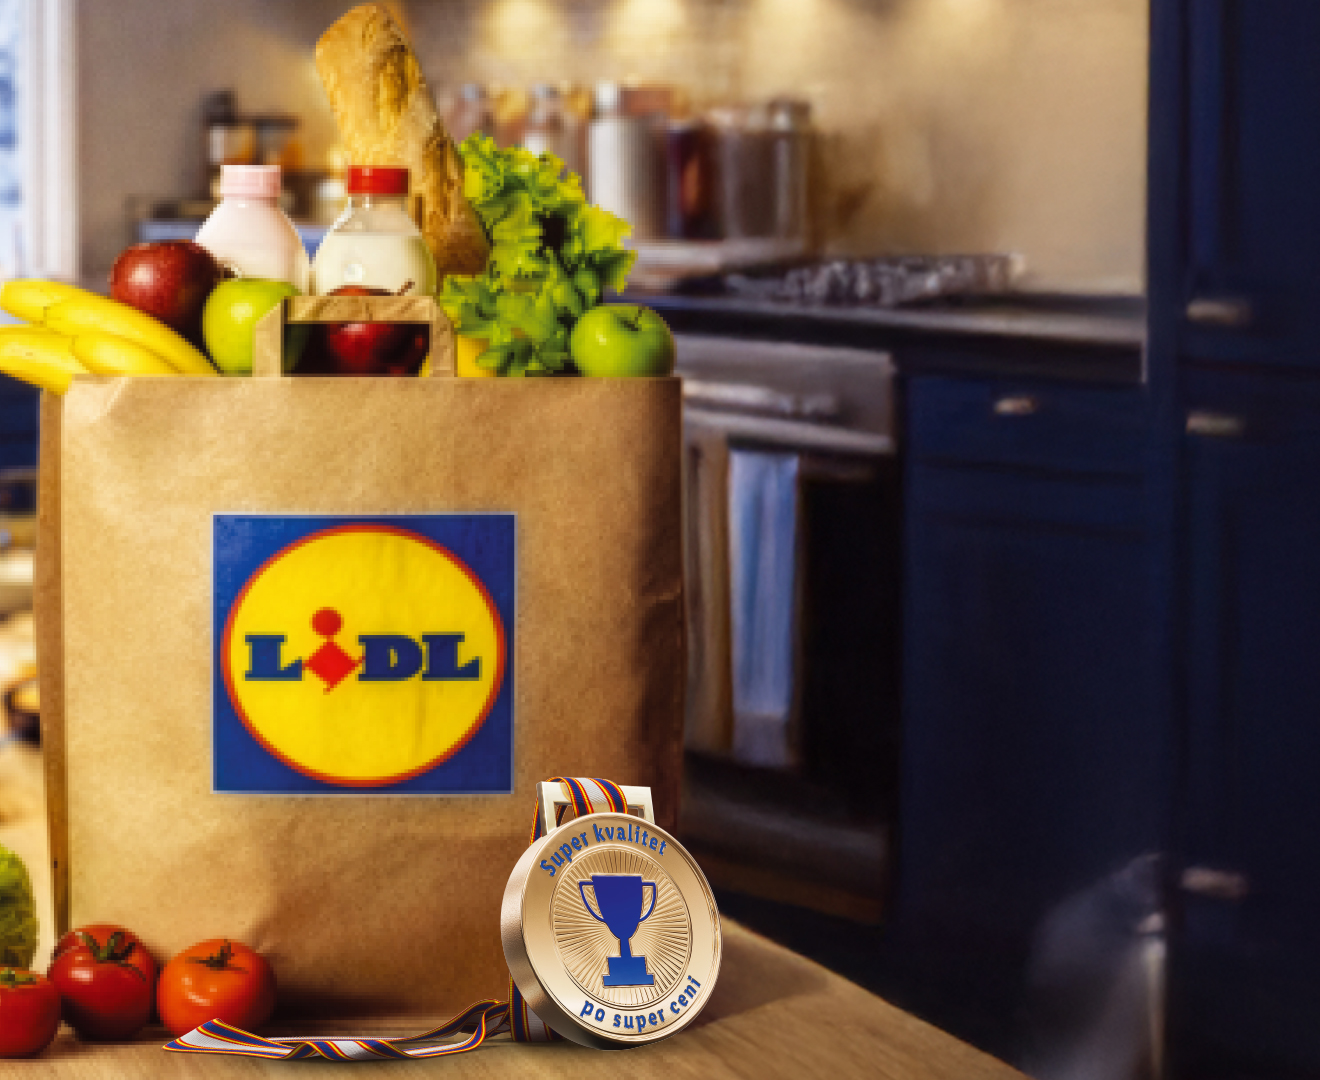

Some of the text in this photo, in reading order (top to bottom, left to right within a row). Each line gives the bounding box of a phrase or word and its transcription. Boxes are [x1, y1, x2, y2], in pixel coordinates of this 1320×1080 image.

[540, 823, 667, 877] Super kvalitet
[580, 975, 701, 1033] po super ceni
